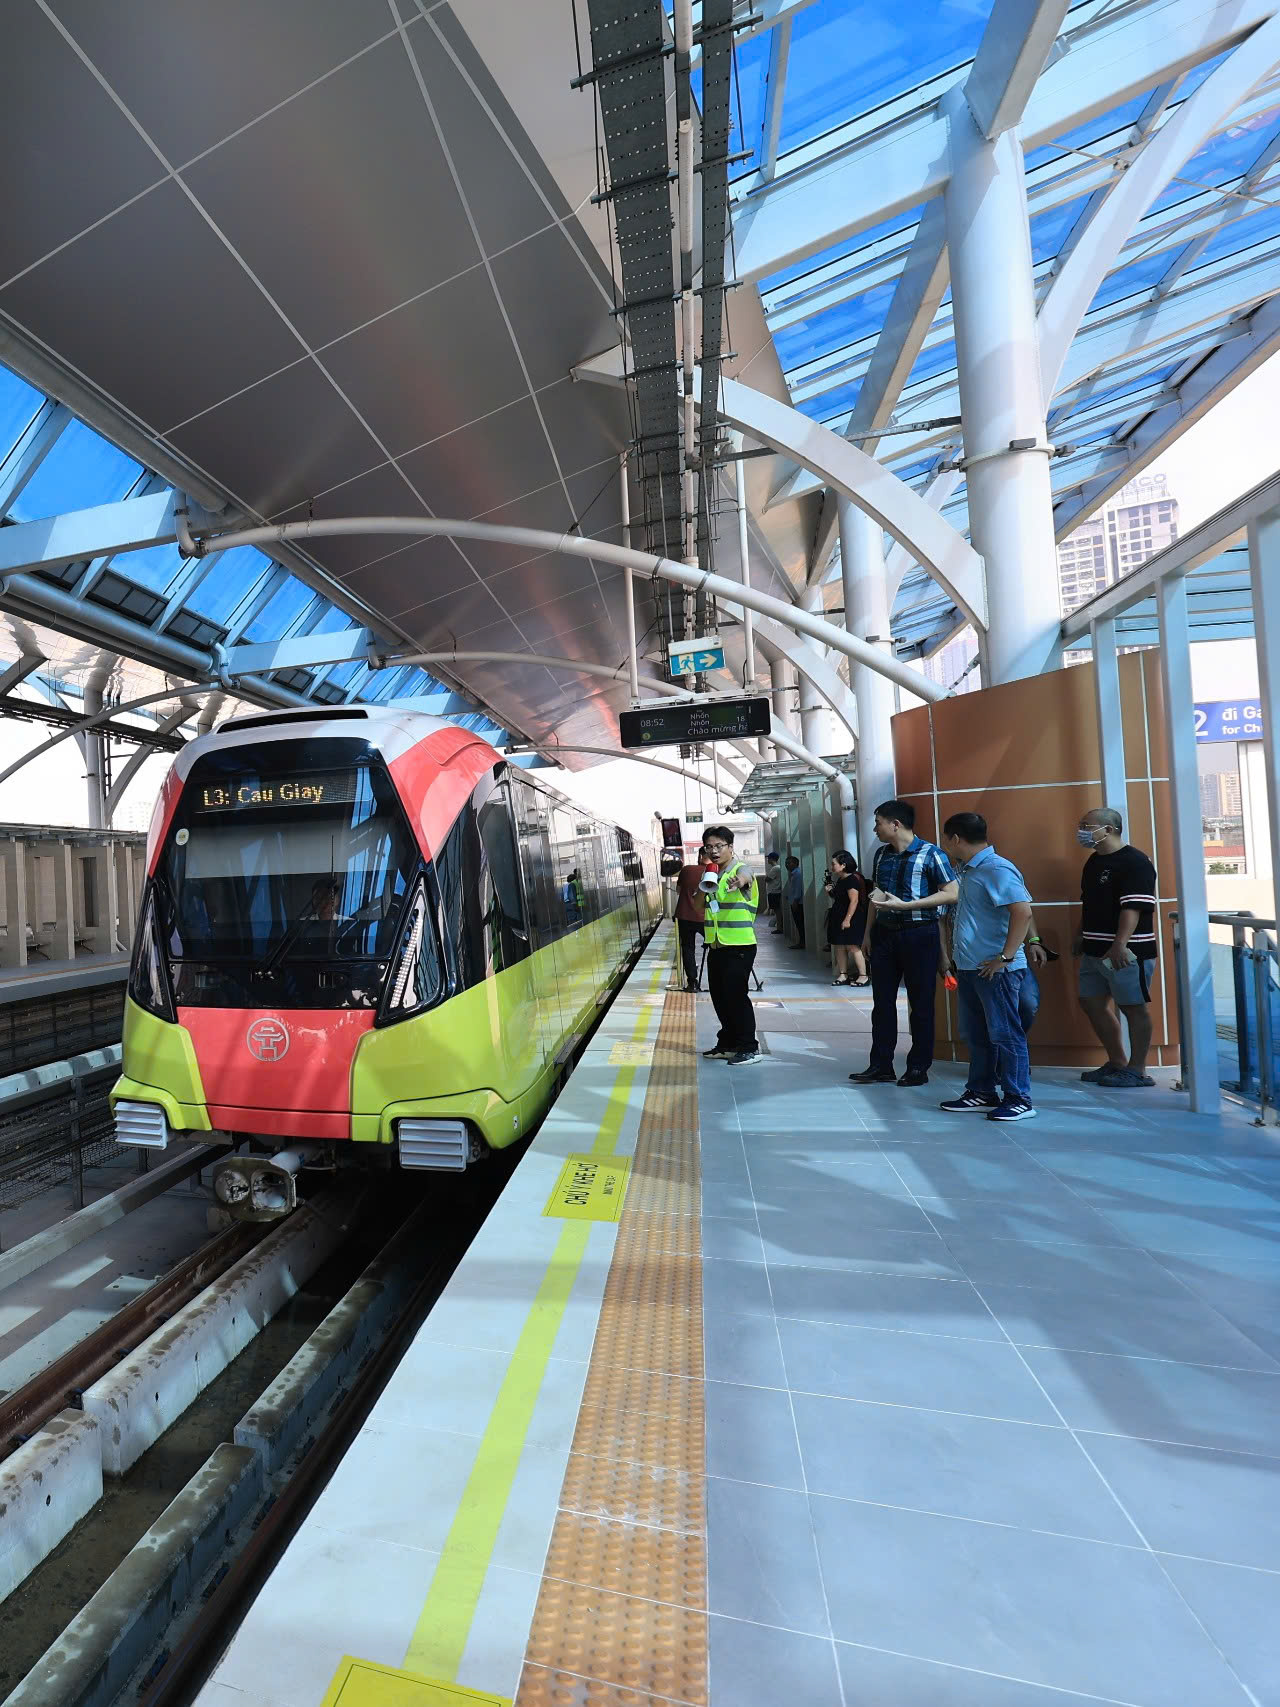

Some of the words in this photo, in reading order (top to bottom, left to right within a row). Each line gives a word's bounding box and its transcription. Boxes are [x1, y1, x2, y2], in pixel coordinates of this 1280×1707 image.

[1222, 707, 1238, 720] đi
[640, 718, 664, 728] 08:52
[1193, 709, 1208, 737] 2
[1222, 725, 1240, 735] for
[1243, 723, 1263, 733] Ch
[203, 789, 230, 806] L3:
[237, 787, 273, 803] Cau
[279, 783, 324, 803] Giay
